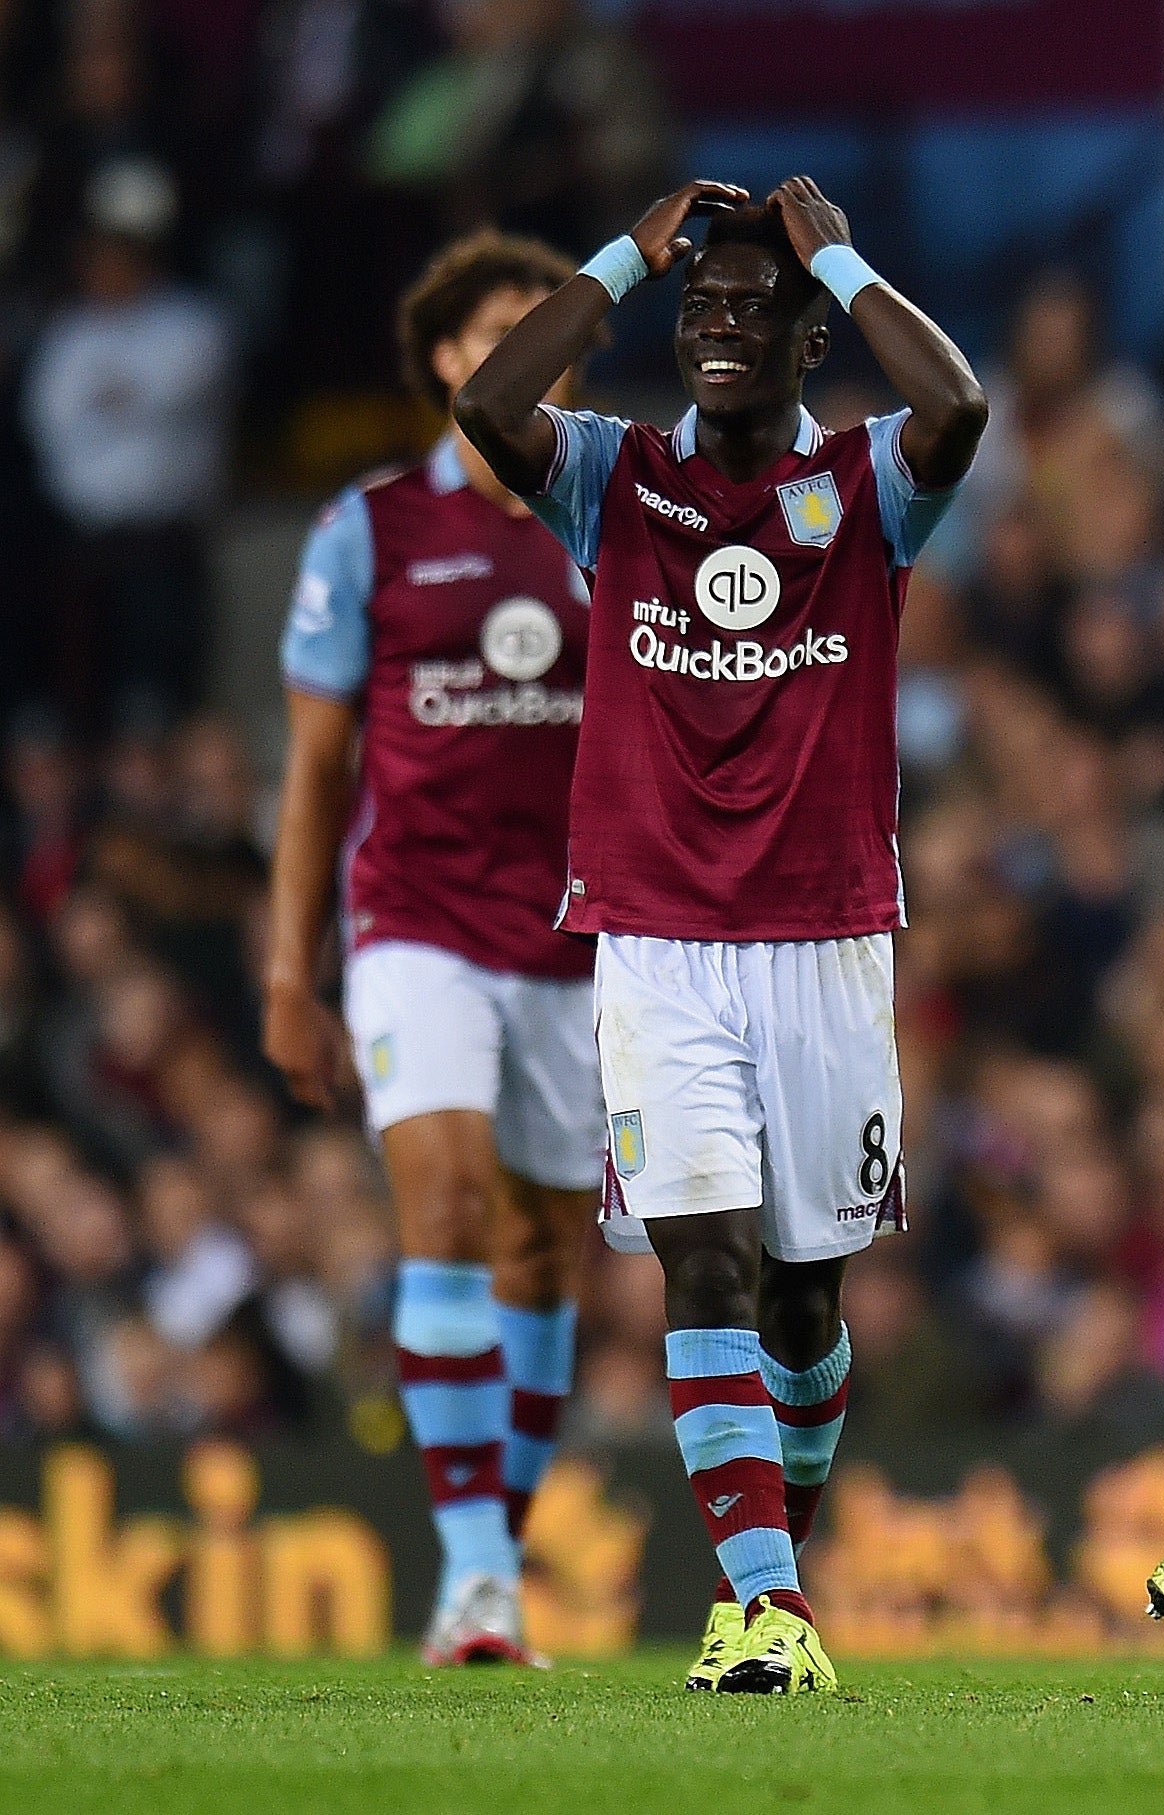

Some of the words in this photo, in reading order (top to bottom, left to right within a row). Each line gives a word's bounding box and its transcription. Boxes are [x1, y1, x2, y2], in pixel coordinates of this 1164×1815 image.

[788, 478, 828, 499] AVFC
[630, 624, 848, 681] QuickBooks
[861, 1111, 889, 1196] 8
